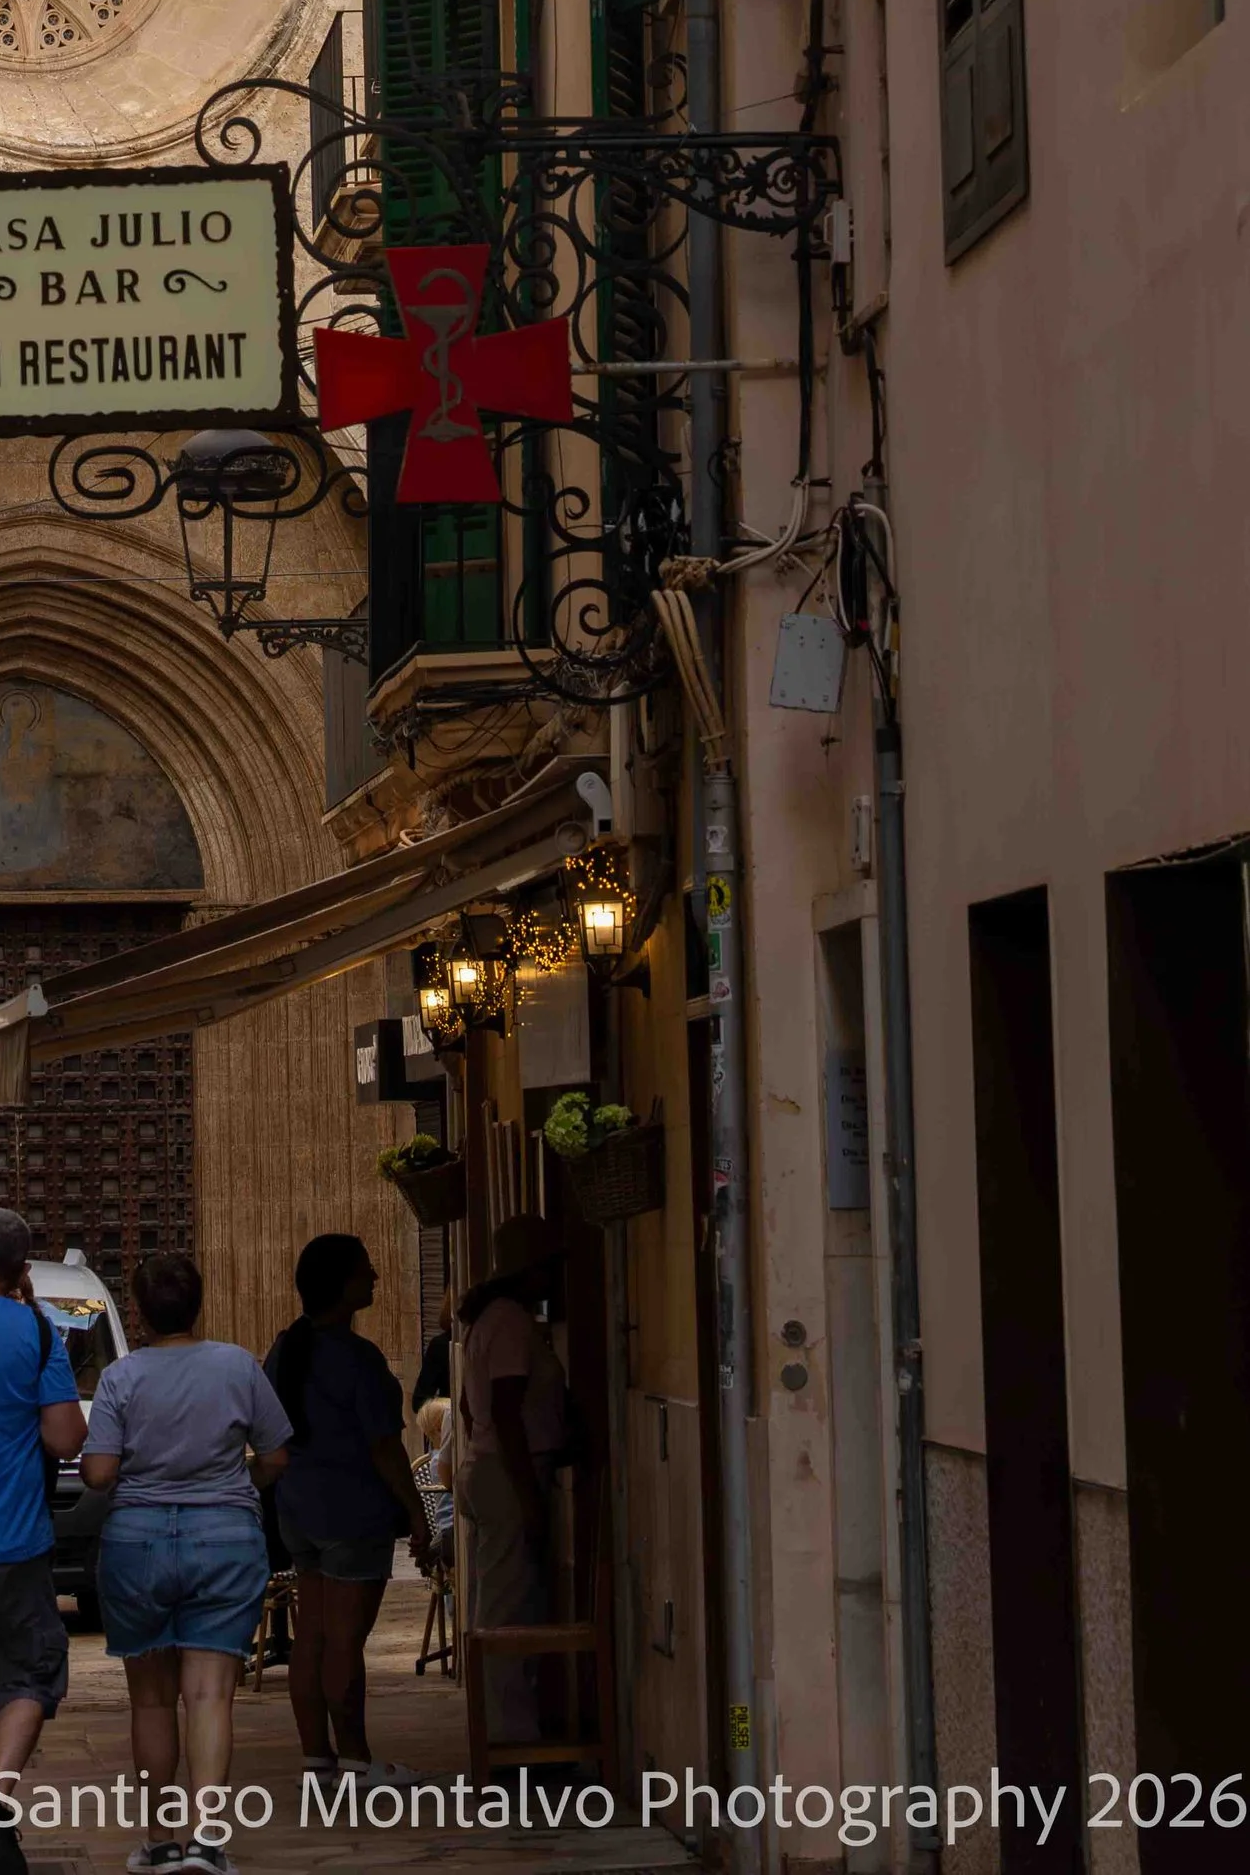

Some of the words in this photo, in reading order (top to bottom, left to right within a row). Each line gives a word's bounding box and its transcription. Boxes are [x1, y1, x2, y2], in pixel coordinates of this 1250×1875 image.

[89, 210, 233, 249] JULIO
[39, 268, 142, 307] BAR
[19, 332, 248, 387] RESTAURANT
